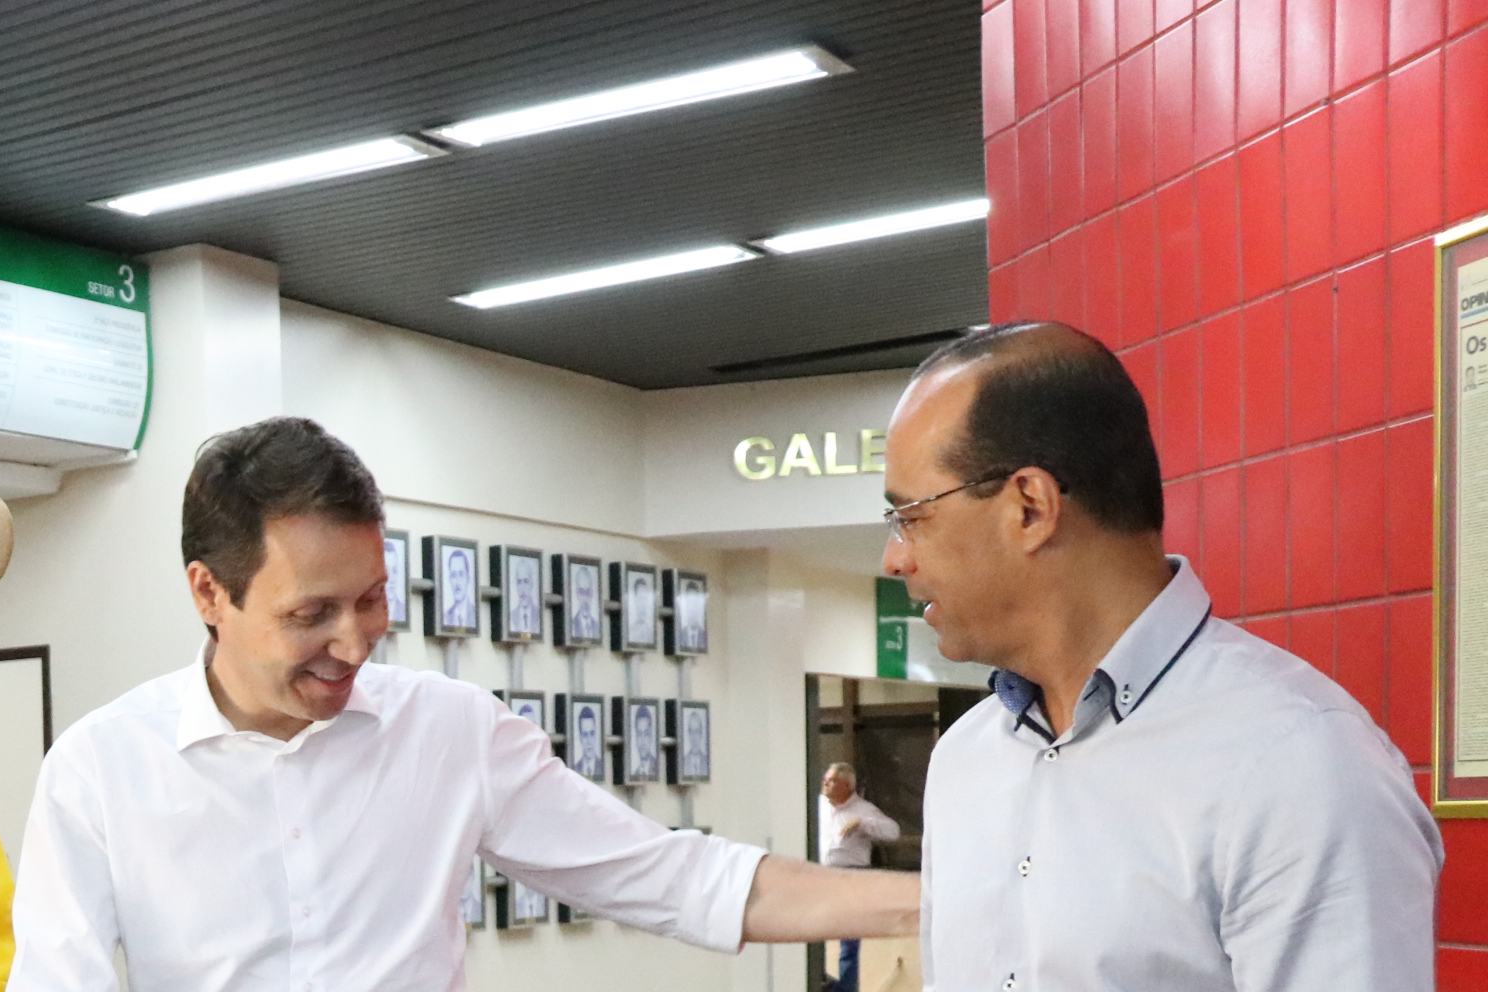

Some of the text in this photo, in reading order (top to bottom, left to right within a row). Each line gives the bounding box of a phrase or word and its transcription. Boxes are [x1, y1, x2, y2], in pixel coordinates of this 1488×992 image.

[87, 264, 136, 303] SETOR 3
[1466, 335, 1487, 355] Os
[733, 428, 886, 480] GALE
